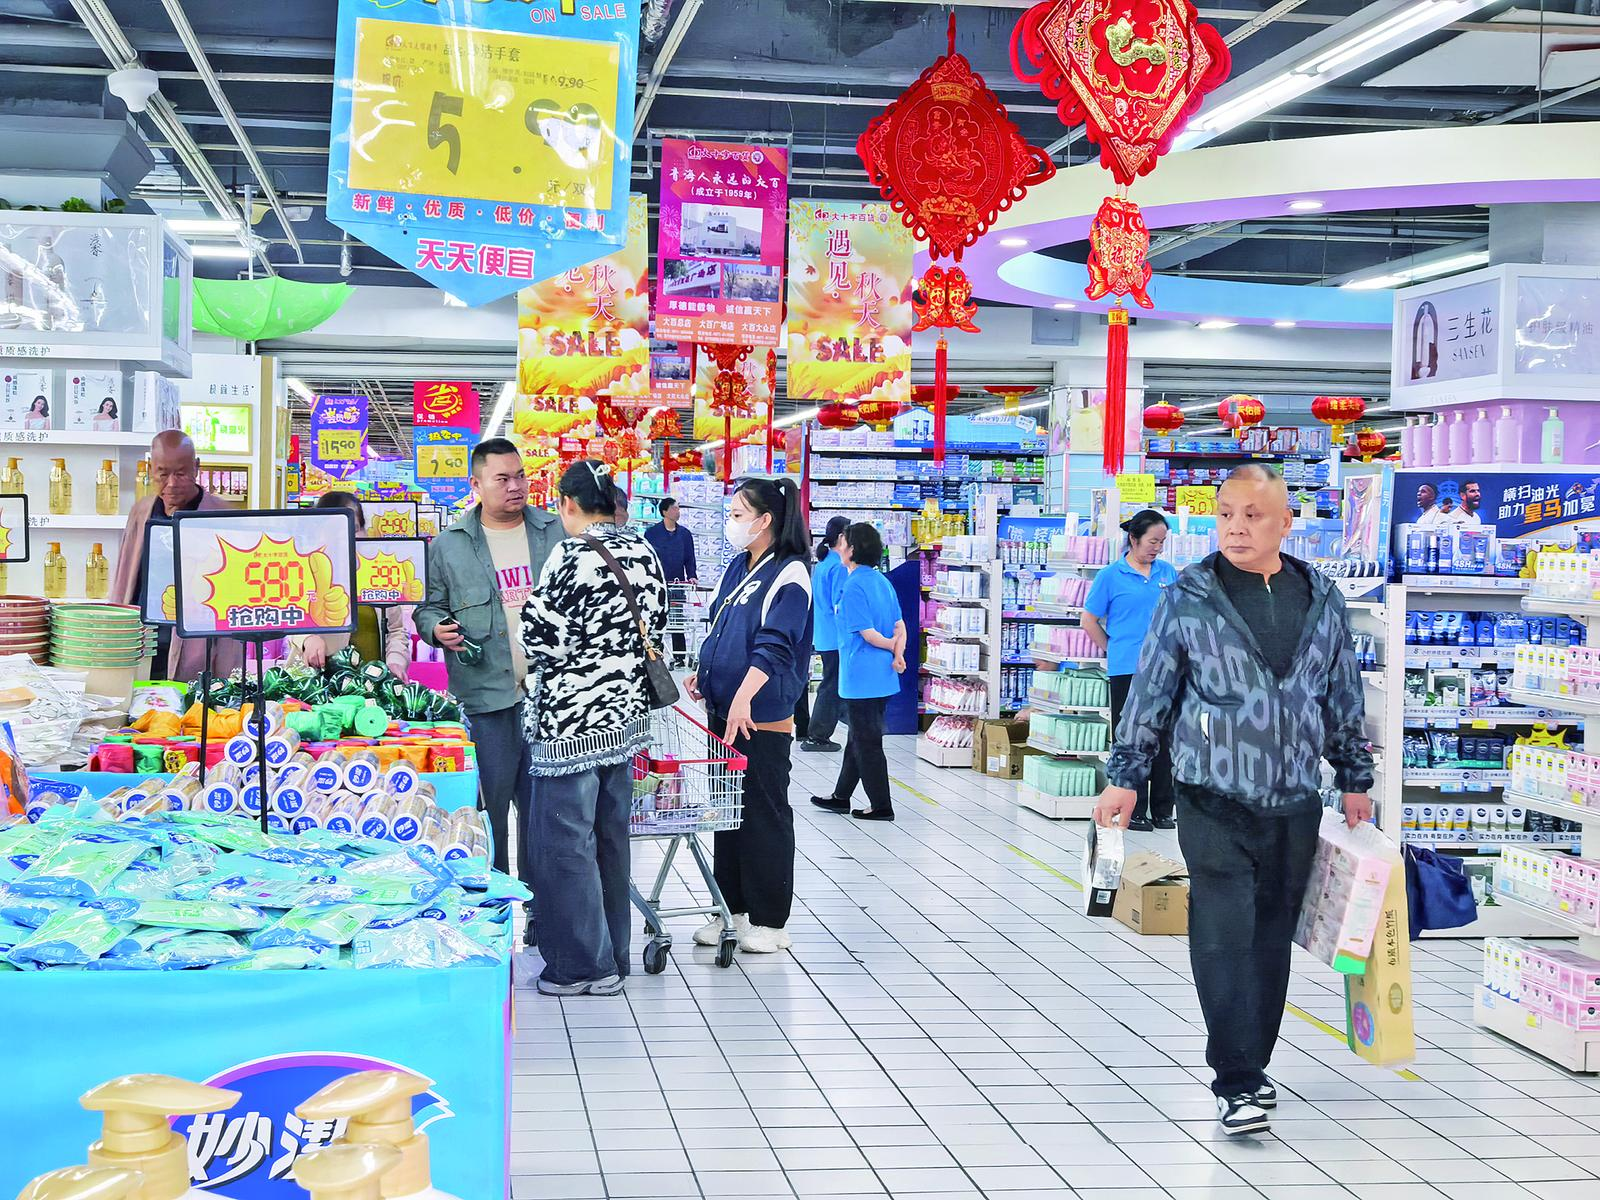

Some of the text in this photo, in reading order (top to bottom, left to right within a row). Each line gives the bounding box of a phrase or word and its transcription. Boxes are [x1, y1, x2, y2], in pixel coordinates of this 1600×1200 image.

[530, 3, 626, 23] ON SALE
[669, 166, 781, 189] 青海人永远的大百
[416, 238, 536, 280] 天天便宜
[586, 263, 617, 322] 秋天
[854, 270, 882, 330] 秋天
[1446, 307, 1493, 342] 三生花
[548, 330, 622, 358] SALE
[815, 336, 886, 363] SALE
[1503, 484, 1560, 503] 横扫油光
[1497, 496, 1596, 525] 助力皇马加冕
[306, 589, 318, 601] 元
[362, 590, 400, 600] 抢购中
[230, 606, 303, 628] 抢购中
